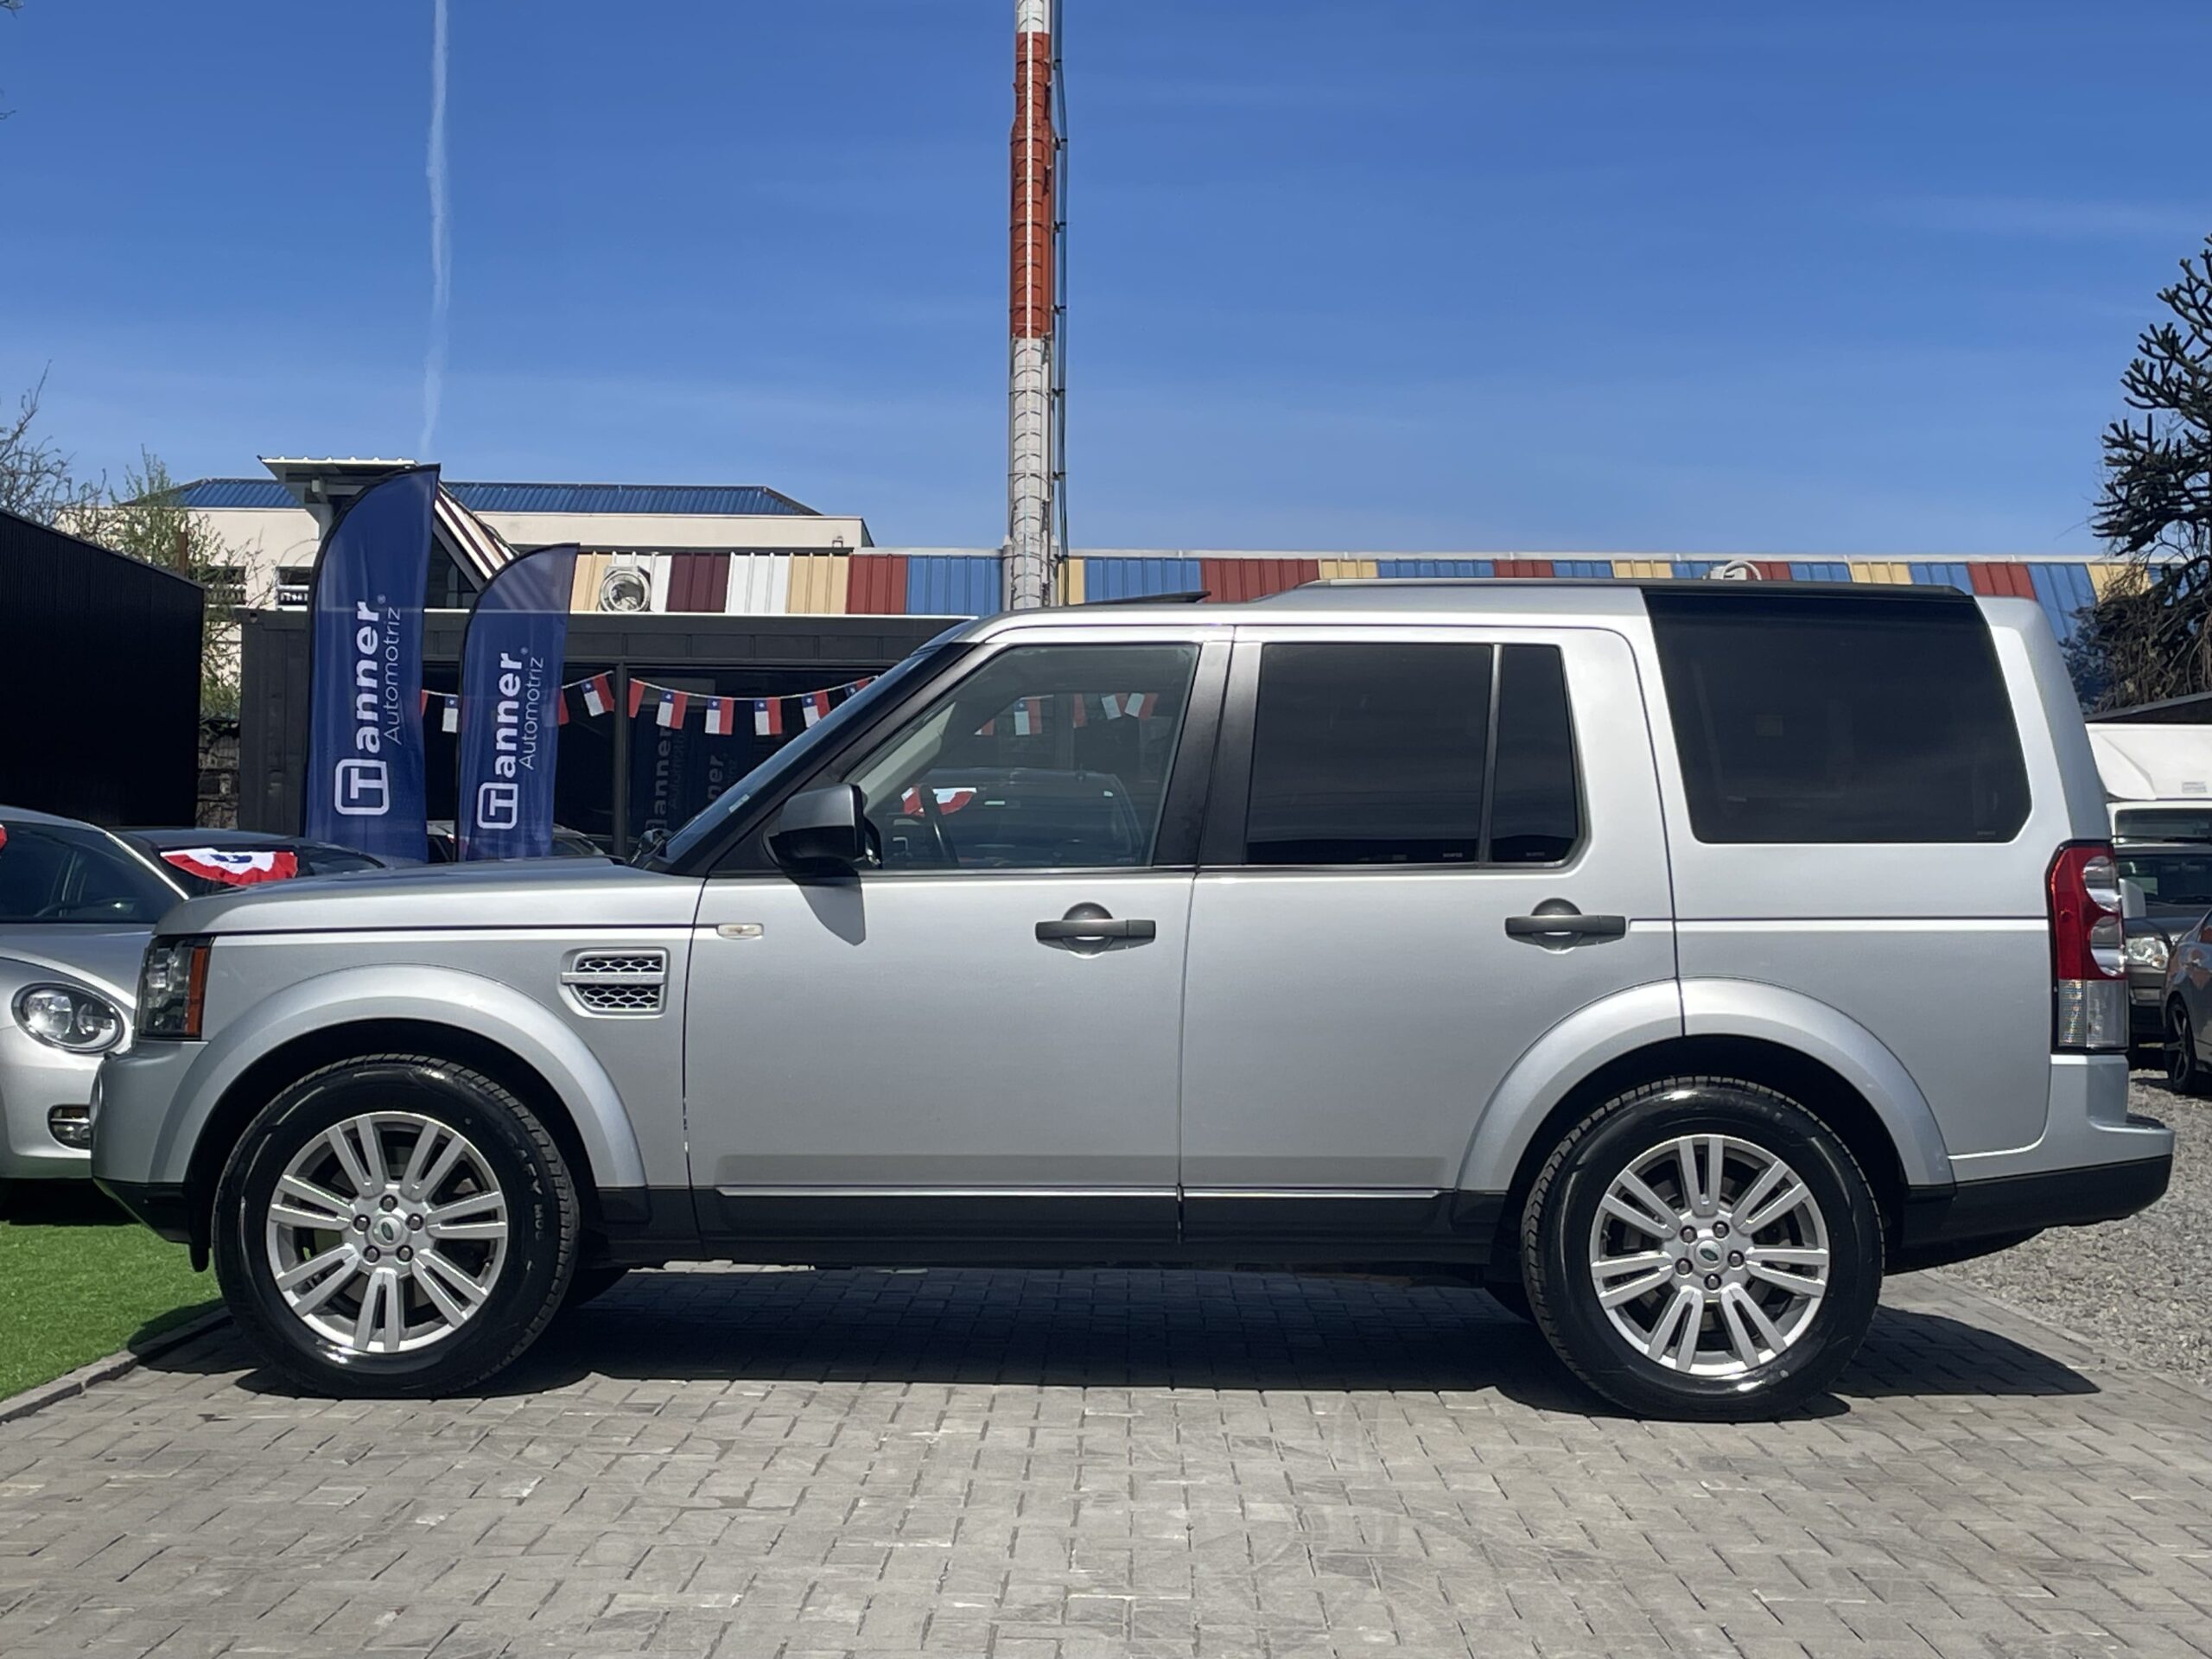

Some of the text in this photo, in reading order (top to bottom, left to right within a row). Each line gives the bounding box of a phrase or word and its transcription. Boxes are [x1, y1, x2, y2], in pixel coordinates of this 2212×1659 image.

[334, 601, 390, 816] Tanner
[383, 607, 403, 745] Automotriz
[477, 652, 522, 830] Tanner
[518, 657, 543, 770] Automotriz
[646, 726, 672, 830] anner
